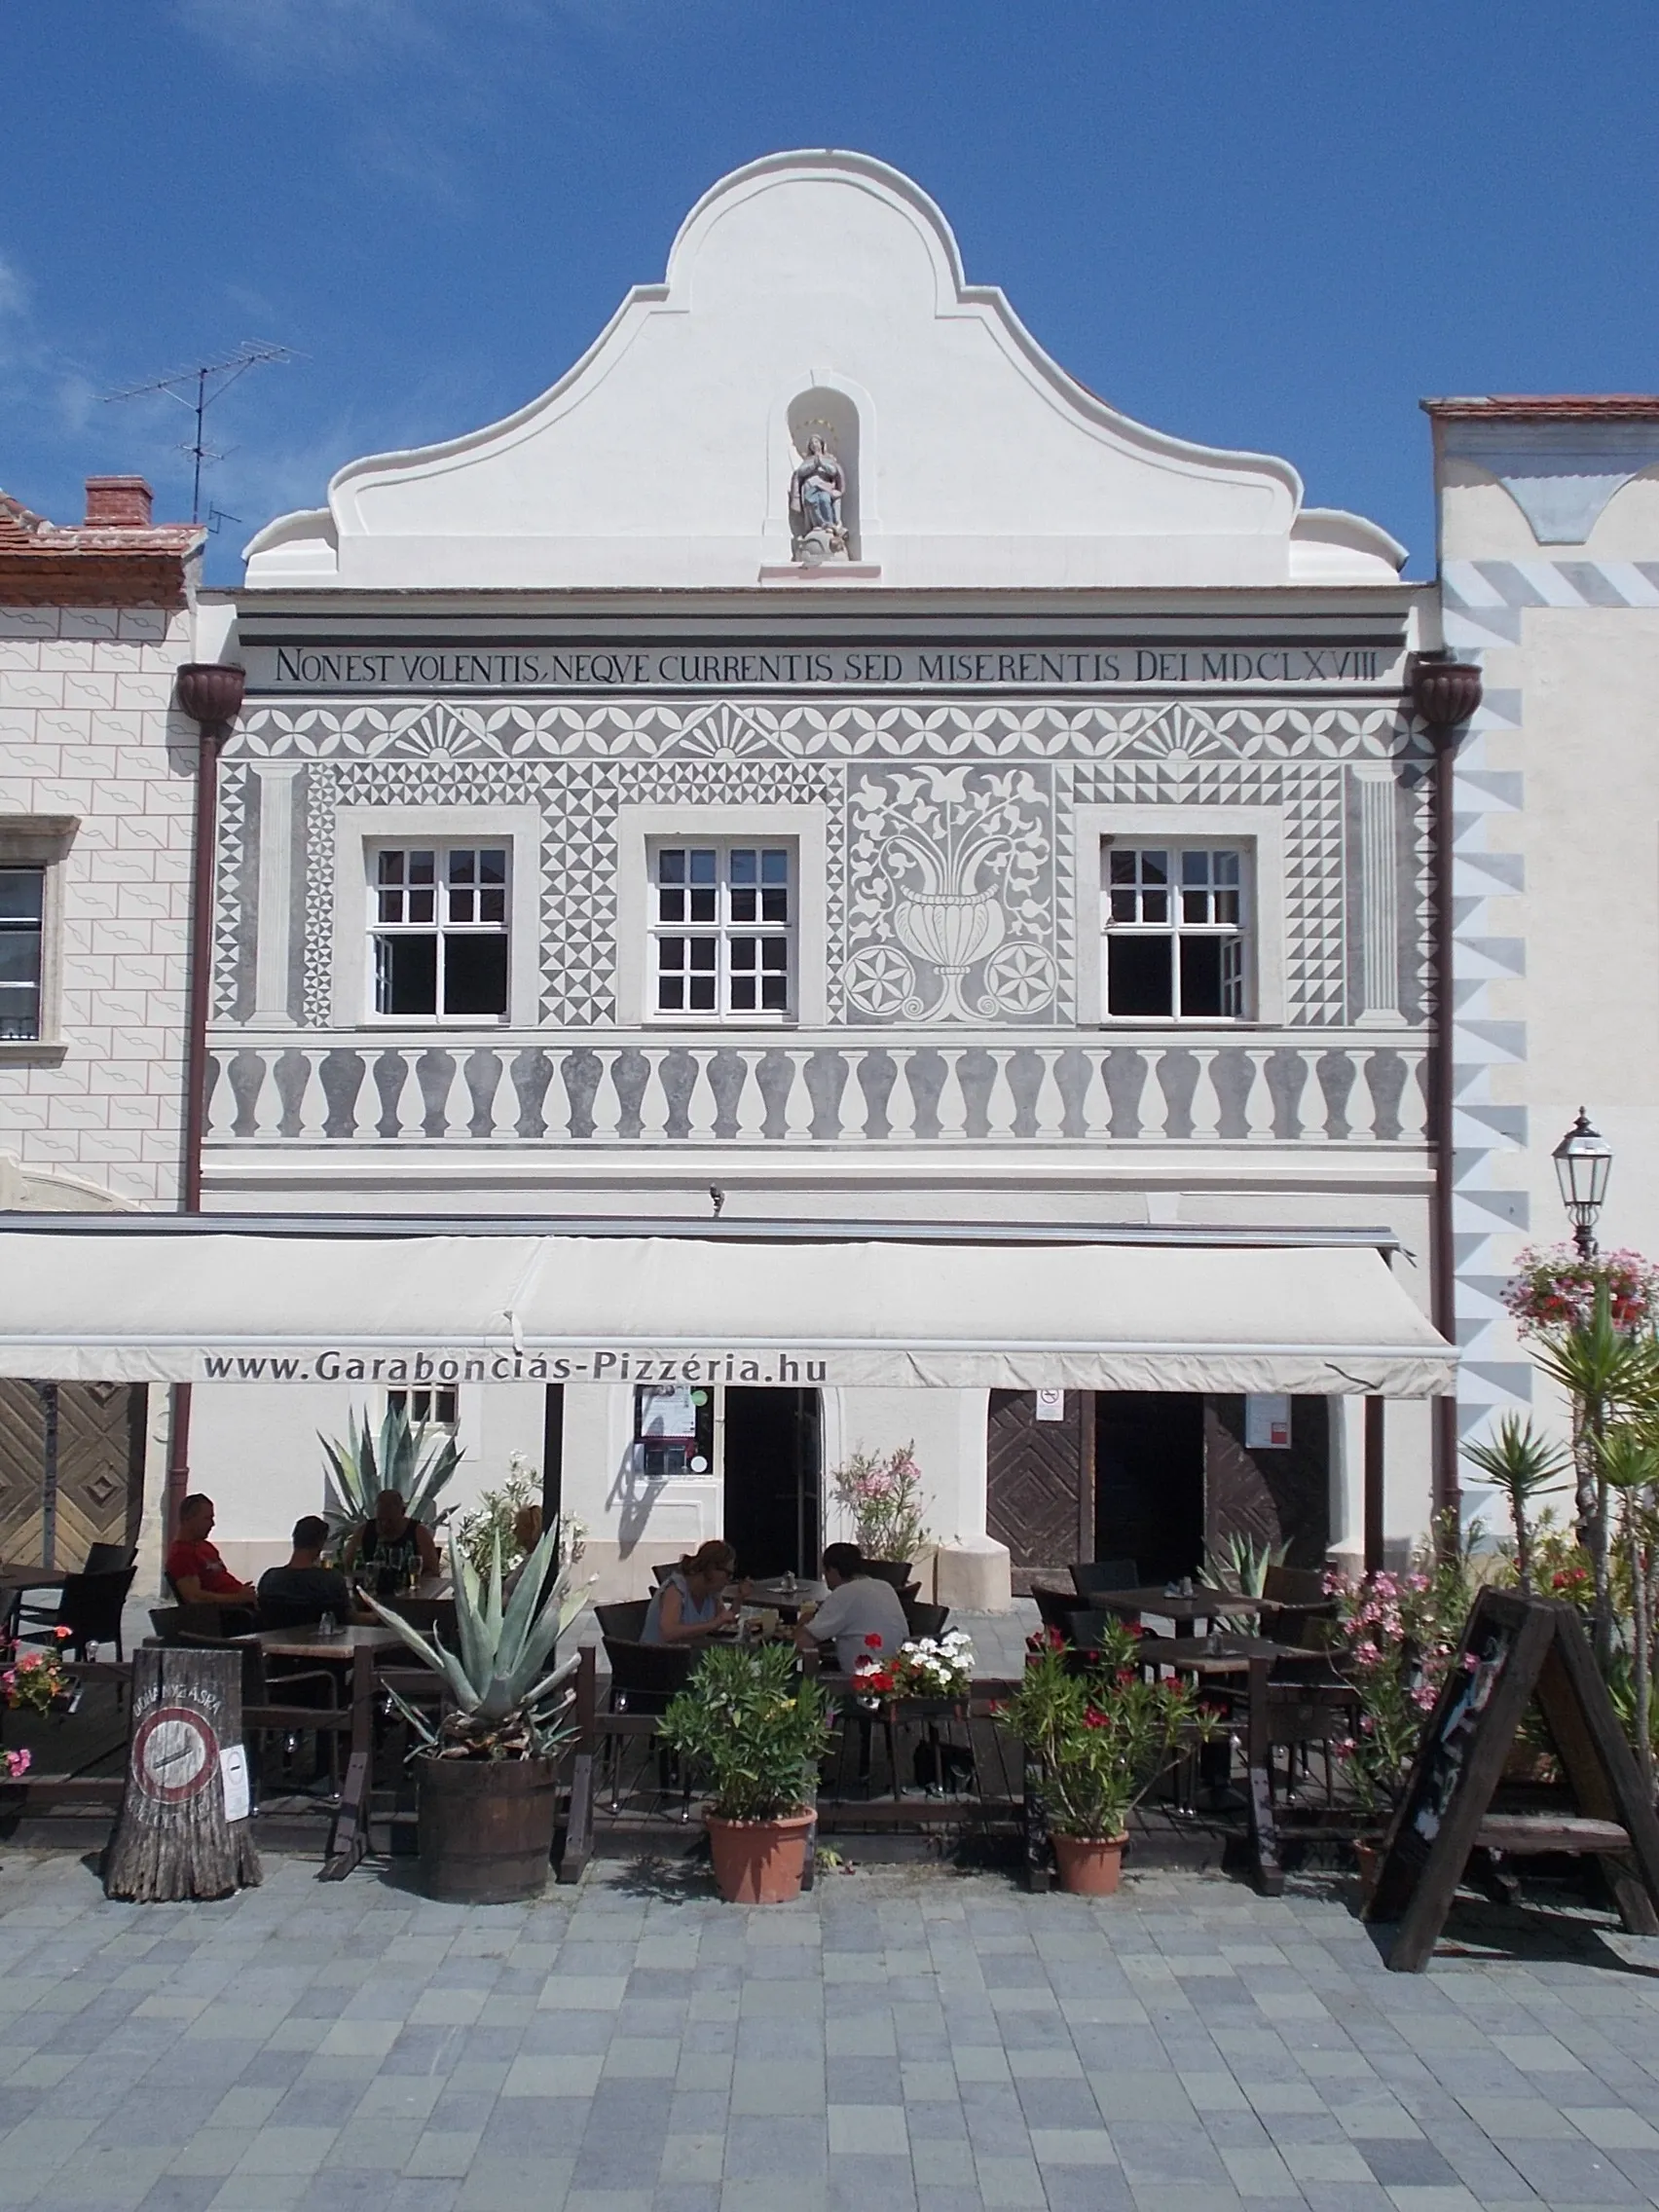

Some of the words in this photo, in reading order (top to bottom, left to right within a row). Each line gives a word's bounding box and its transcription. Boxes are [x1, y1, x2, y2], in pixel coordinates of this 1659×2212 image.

[552, 654, 649, 682] NEQVE
[658, 654, 833, 682] CURRENTIS
[843, 653, 902, 682] SED
[918, 653, 1120, 682] MISERENTIS
[1135, 649, 1187, 682] DEI
[1201, 650, 1378, 682] MDCLXVIII
[204, 1349, 827, 1382] www.Garabonciás-Pizzéria.hu
